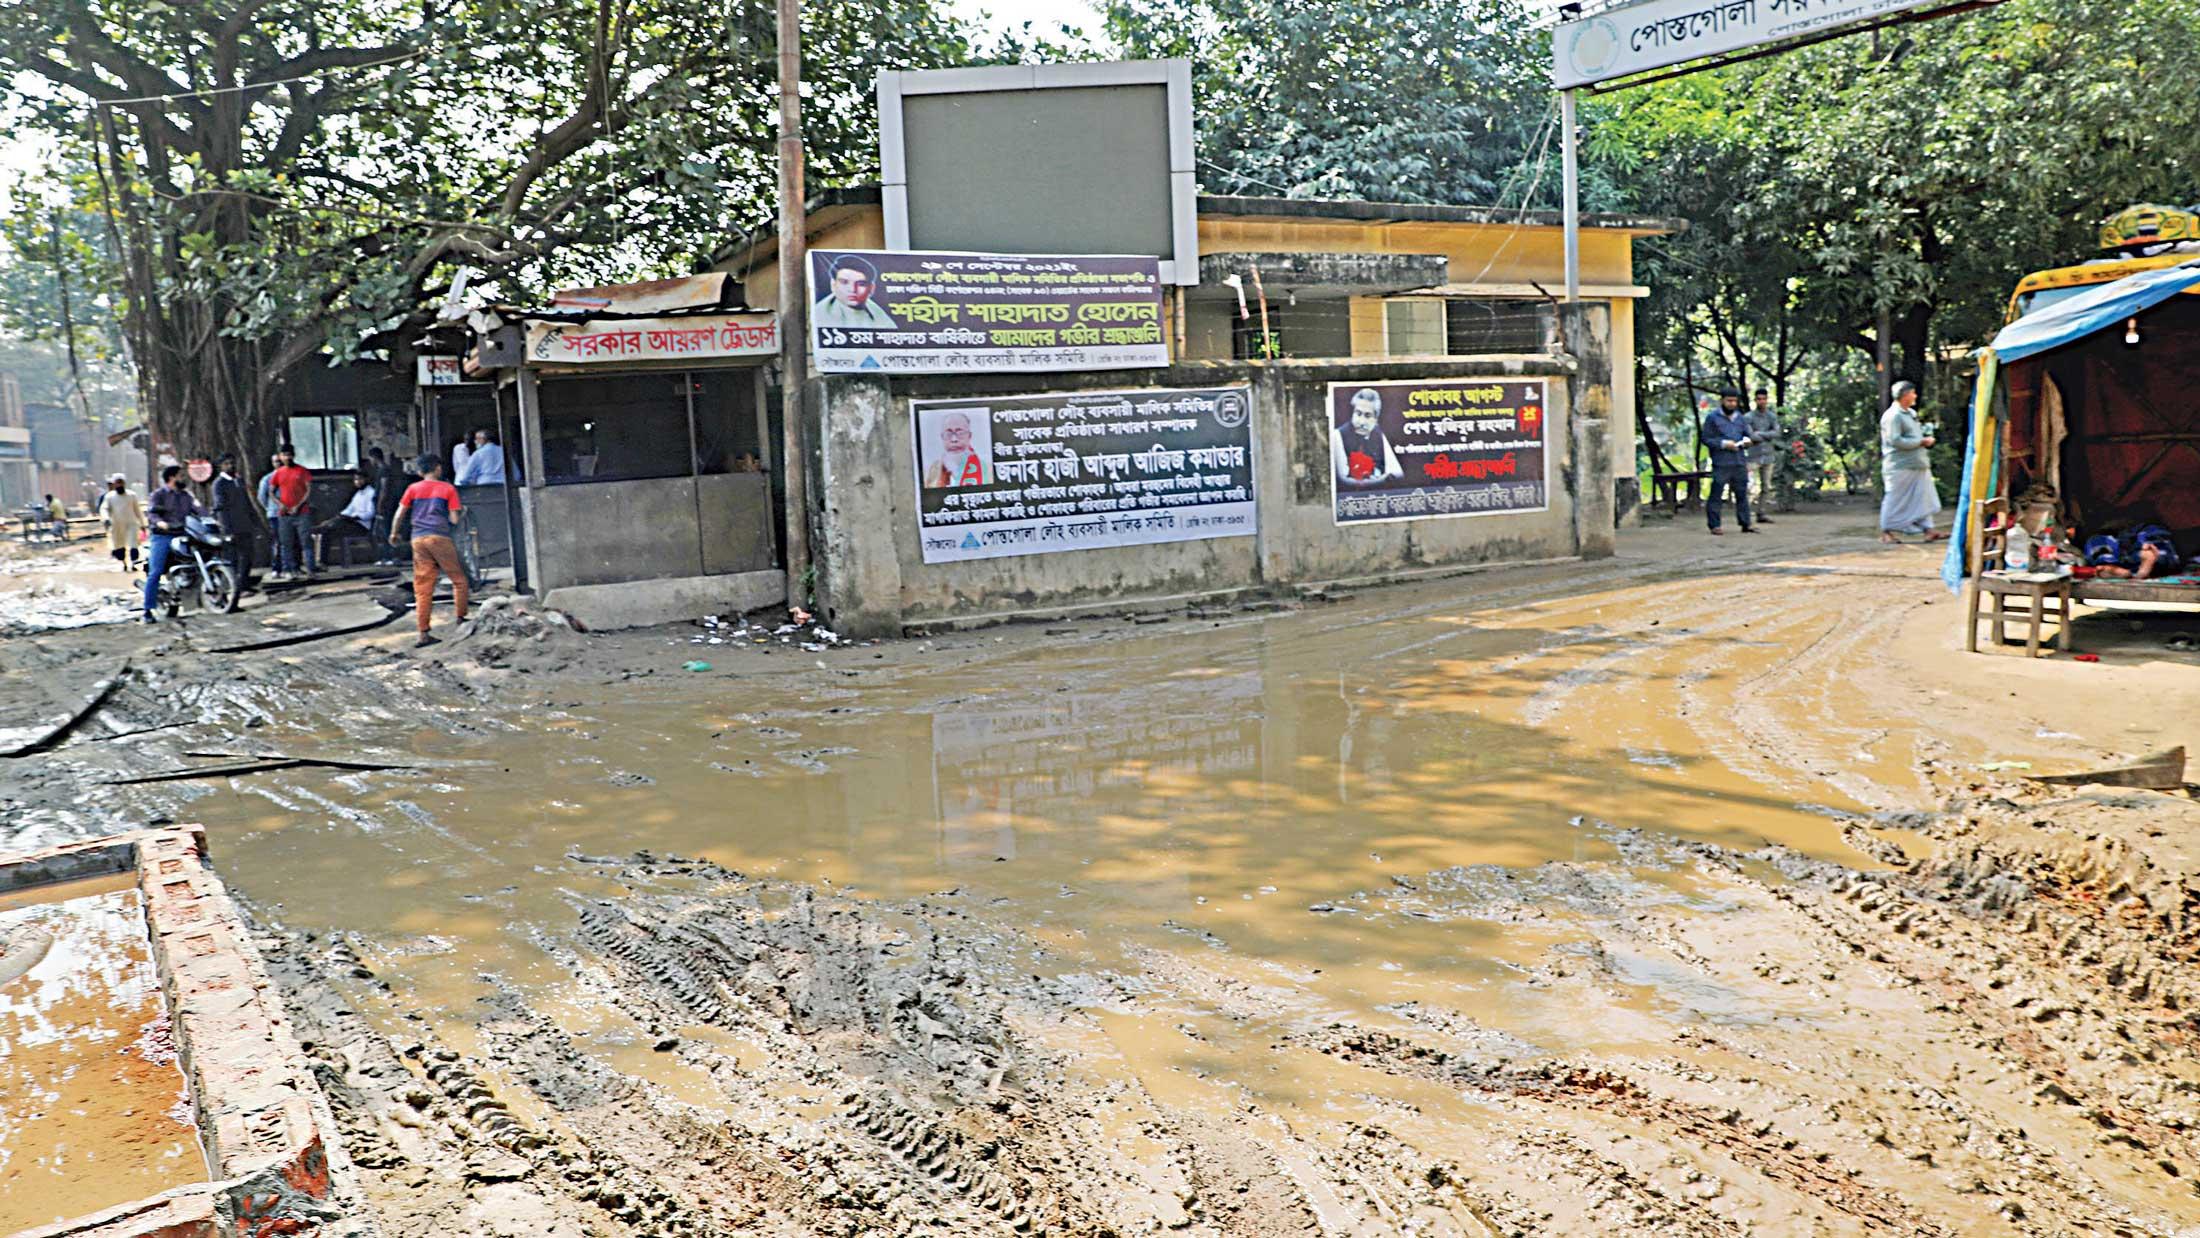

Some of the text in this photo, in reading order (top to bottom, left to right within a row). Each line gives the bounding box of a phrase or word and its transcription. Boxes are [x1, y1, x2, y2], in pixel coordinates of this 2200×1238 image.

[1631, 1, 1756, 51] পোস্তগোলা
[888, 296, 1159, 324] শহীদ শাহাদাত হোসেন
[562, 320, 777, 357] সরকার আয়রণ ট্রেডার্স
[822, 321, 1161, 346] ১৯ তম শাহাদাত বার্ষিকীতে আমাদের গভীর শ্রদ্ধাঞ্জলি
[882, 354, 940, 368] পোস্তগোলা
[974, 350, 1015, 367] ব্যবসায়ী
[1019, 350, 1051, 365] মালিক
[1055, 349, 1085, 364] সমিতি
[1409, 385, 1504, 406] শোকাবহ আগস্ট
[993, 397, 1214, 423] পোস্তগোলা লৌহ ব্যবসায়ী মালিক সমিতির
[1013, 418, 1198, 440] সাবেক প্রতিষ্ঠাতা সাধারণ সম্পাদক
[1404, 418, 1516, 436] শেখ মুজিবুর রহমান
[993, 442, 1013, 456] বীর
[994, 458, 1040, 483] জনাব
[1041, 448, 1080, 483] হাজী
[1132, 444, 1186, 474] আজিজ
[982, 526, 1036, 546] পোস্তগোলা
[1069, 515, 1107, 538] ব্যবসায়ী
[1111, 514, 1141, 534] মালিক
[1145, 511, 1175, 530] সমিতি
